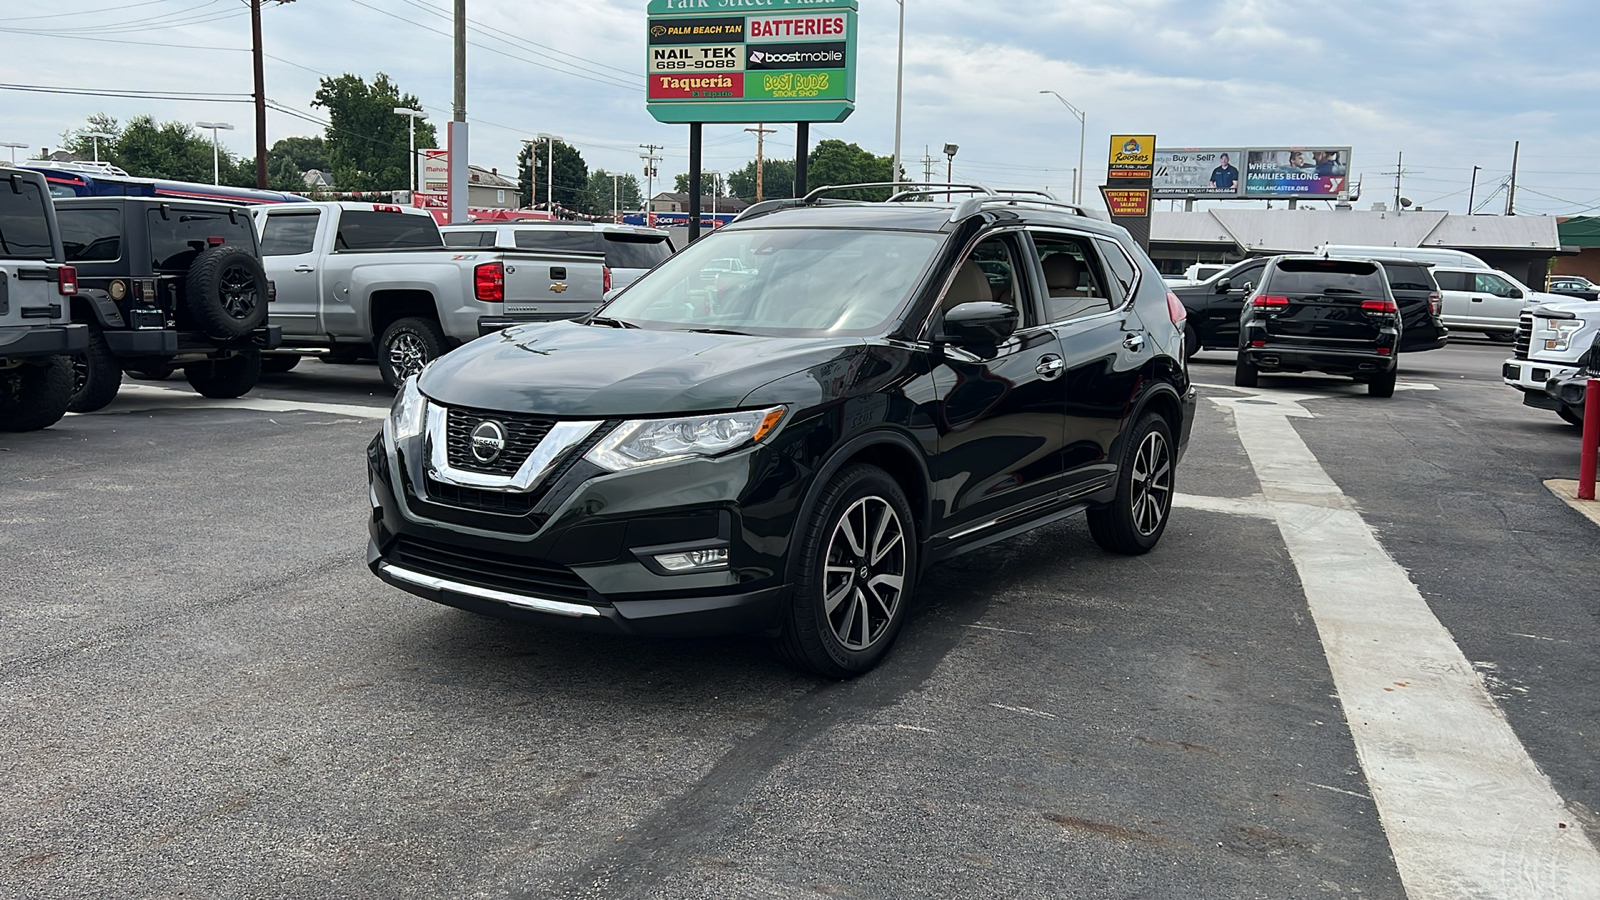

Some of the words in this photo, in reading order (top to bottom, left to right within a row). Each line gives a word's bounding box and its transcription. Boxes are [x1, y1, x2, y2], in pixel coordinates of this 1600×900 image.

[668, 27, 690, 35] PALM
[693, 26, 721, 34] BEACH
[725, 25, 742, 33] TAN
[751, 18, 843, 37] BATTERIES
[654, 49, 693, 60] NAIL
[701, 48, 736, 58] TEK
[656, 60, 735, 69] 689-9088
[1114, 152, 1149, 163] Roosters
[1172, 154, 1188, 162] Buy
[473, 438, 500, 448] NISSAN
